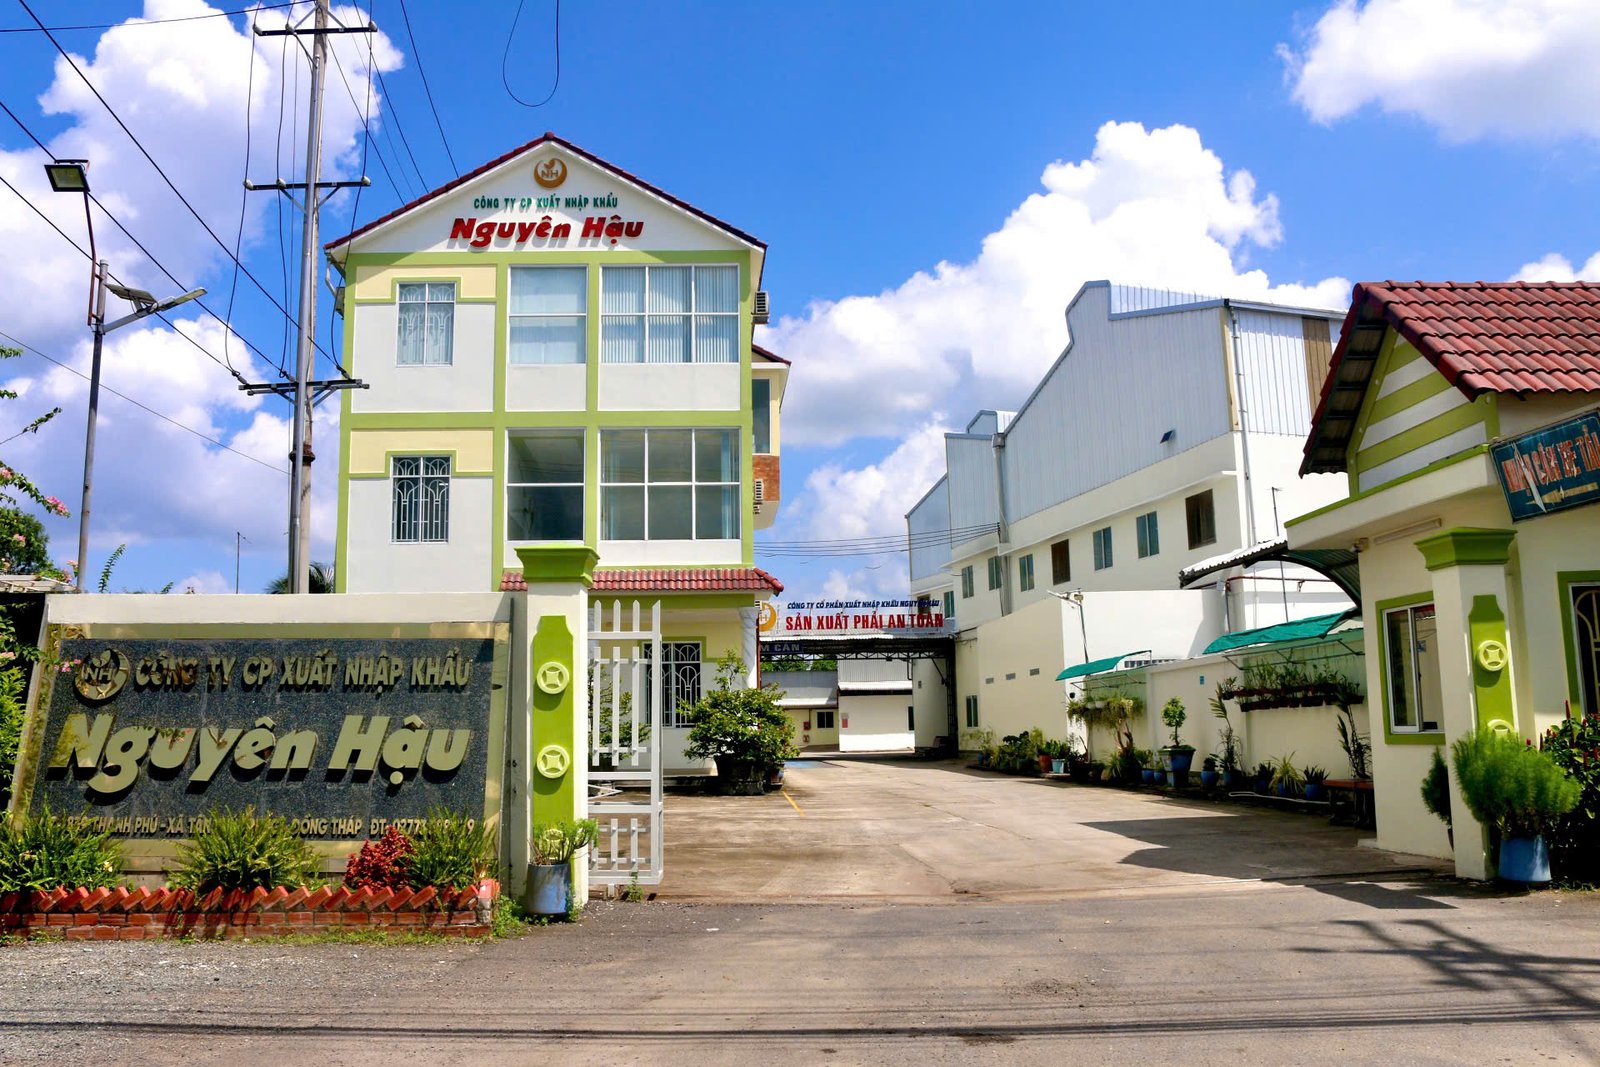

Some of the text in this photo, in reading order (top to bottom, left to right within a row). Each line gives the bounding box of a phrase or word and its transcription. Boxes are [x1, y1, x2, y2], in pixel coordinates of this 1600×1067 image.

[541, 170, 558, 178] NH
[474, 195, 499, 209] CÔNG
[504, 198, 516, 208] TY
[520, 197, 532, 209] CP
[536, 193, 560, 208] XUẤT
[565, 194, 589, 211] NHẬP
[450, 214, 644, 248] Nguyên Hậu
[786, 612, 812, 630] SẢN
[817, 611, 849, 629] XUẤT
[854, 610, 883, 629] PHẢI
[888, 614, 905, 628] AN
[81, 656, 113, 682] NH
[135, 646, 471, 694] CÔNG TY CP XUẤT NHẬP KHẨU
[48, 713, 471, 794] Nguyên Hậu
[134, 814, 158, 833] PHÚ
[166, 813, 184, 833] XÃ
[331, 815, 363, 835] THÁP
